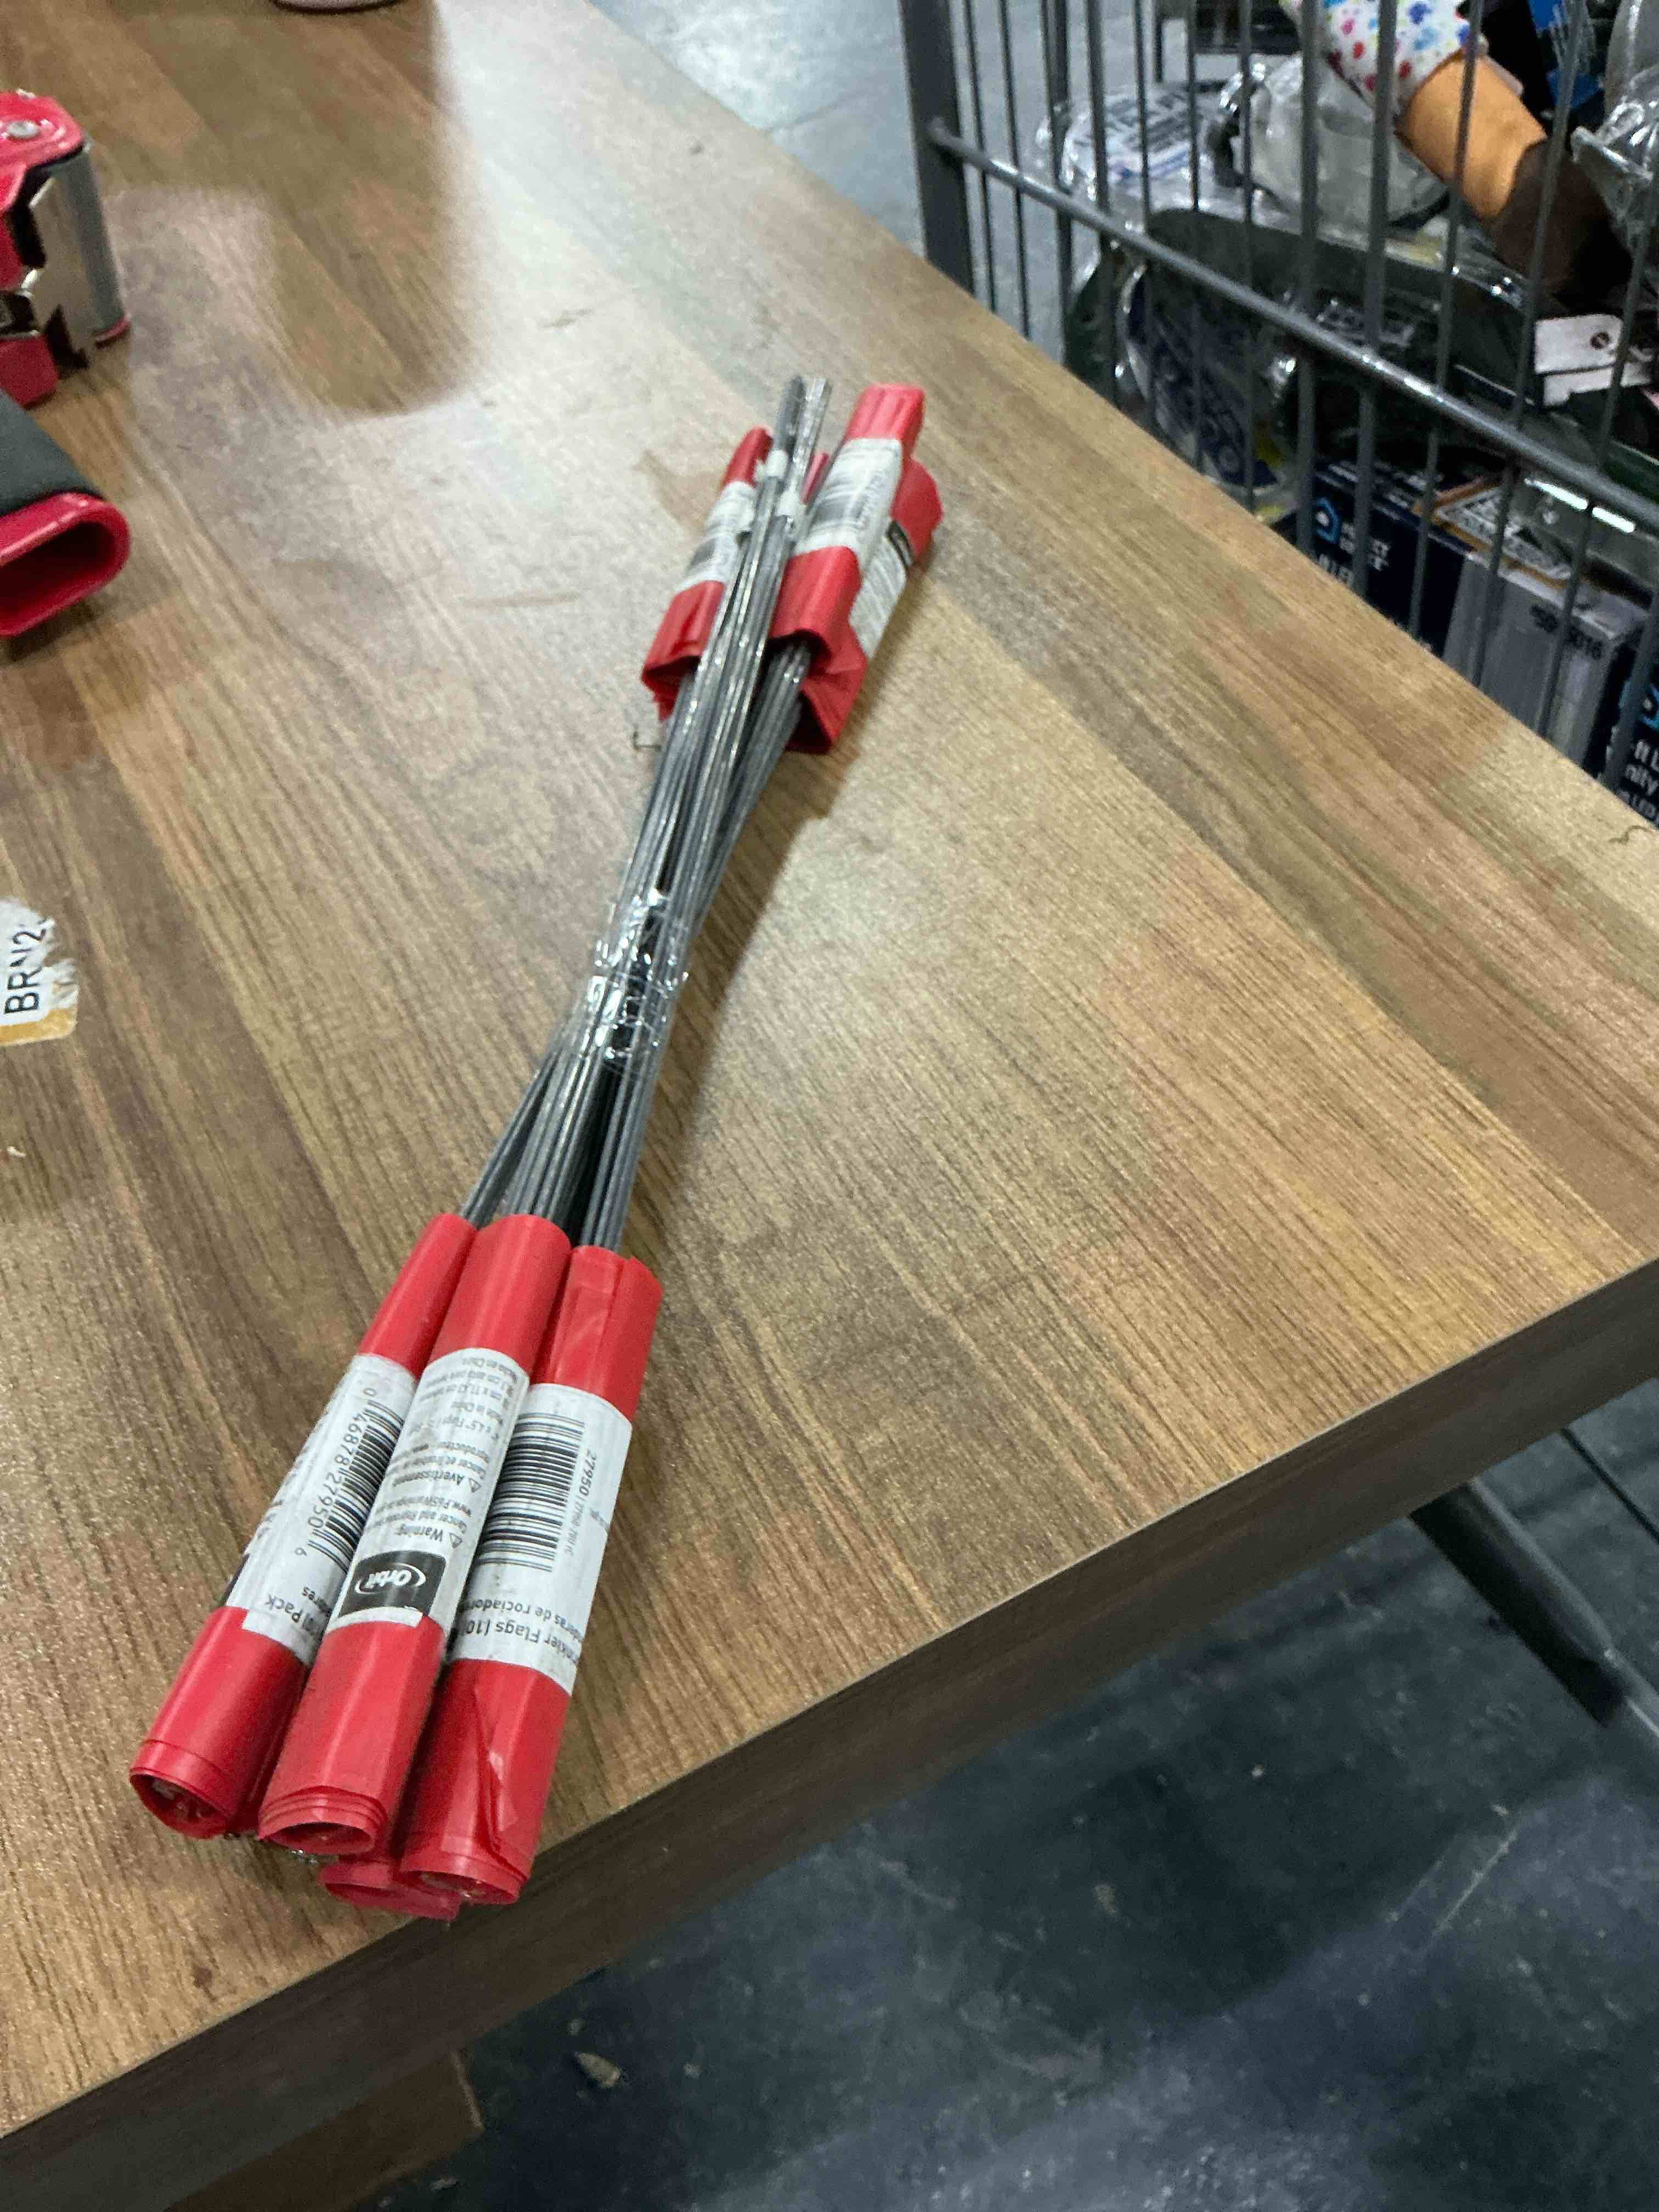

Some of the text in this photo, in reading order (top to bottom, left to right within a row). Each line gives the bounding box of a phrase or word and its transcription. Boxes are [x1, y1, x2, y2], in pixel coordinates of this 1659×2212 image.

[334, 1412, 367, 1466] 46878
[579, 1448, 597, 1497] 27950
[308, 1472, 342, 1528] 27950
[295, 1547, 307, 1557] 6
[265, 1594, 303, 1622] Pack
[535, 1607, 552, 1622] de
[496, 1619, 541, 1644] Flags
